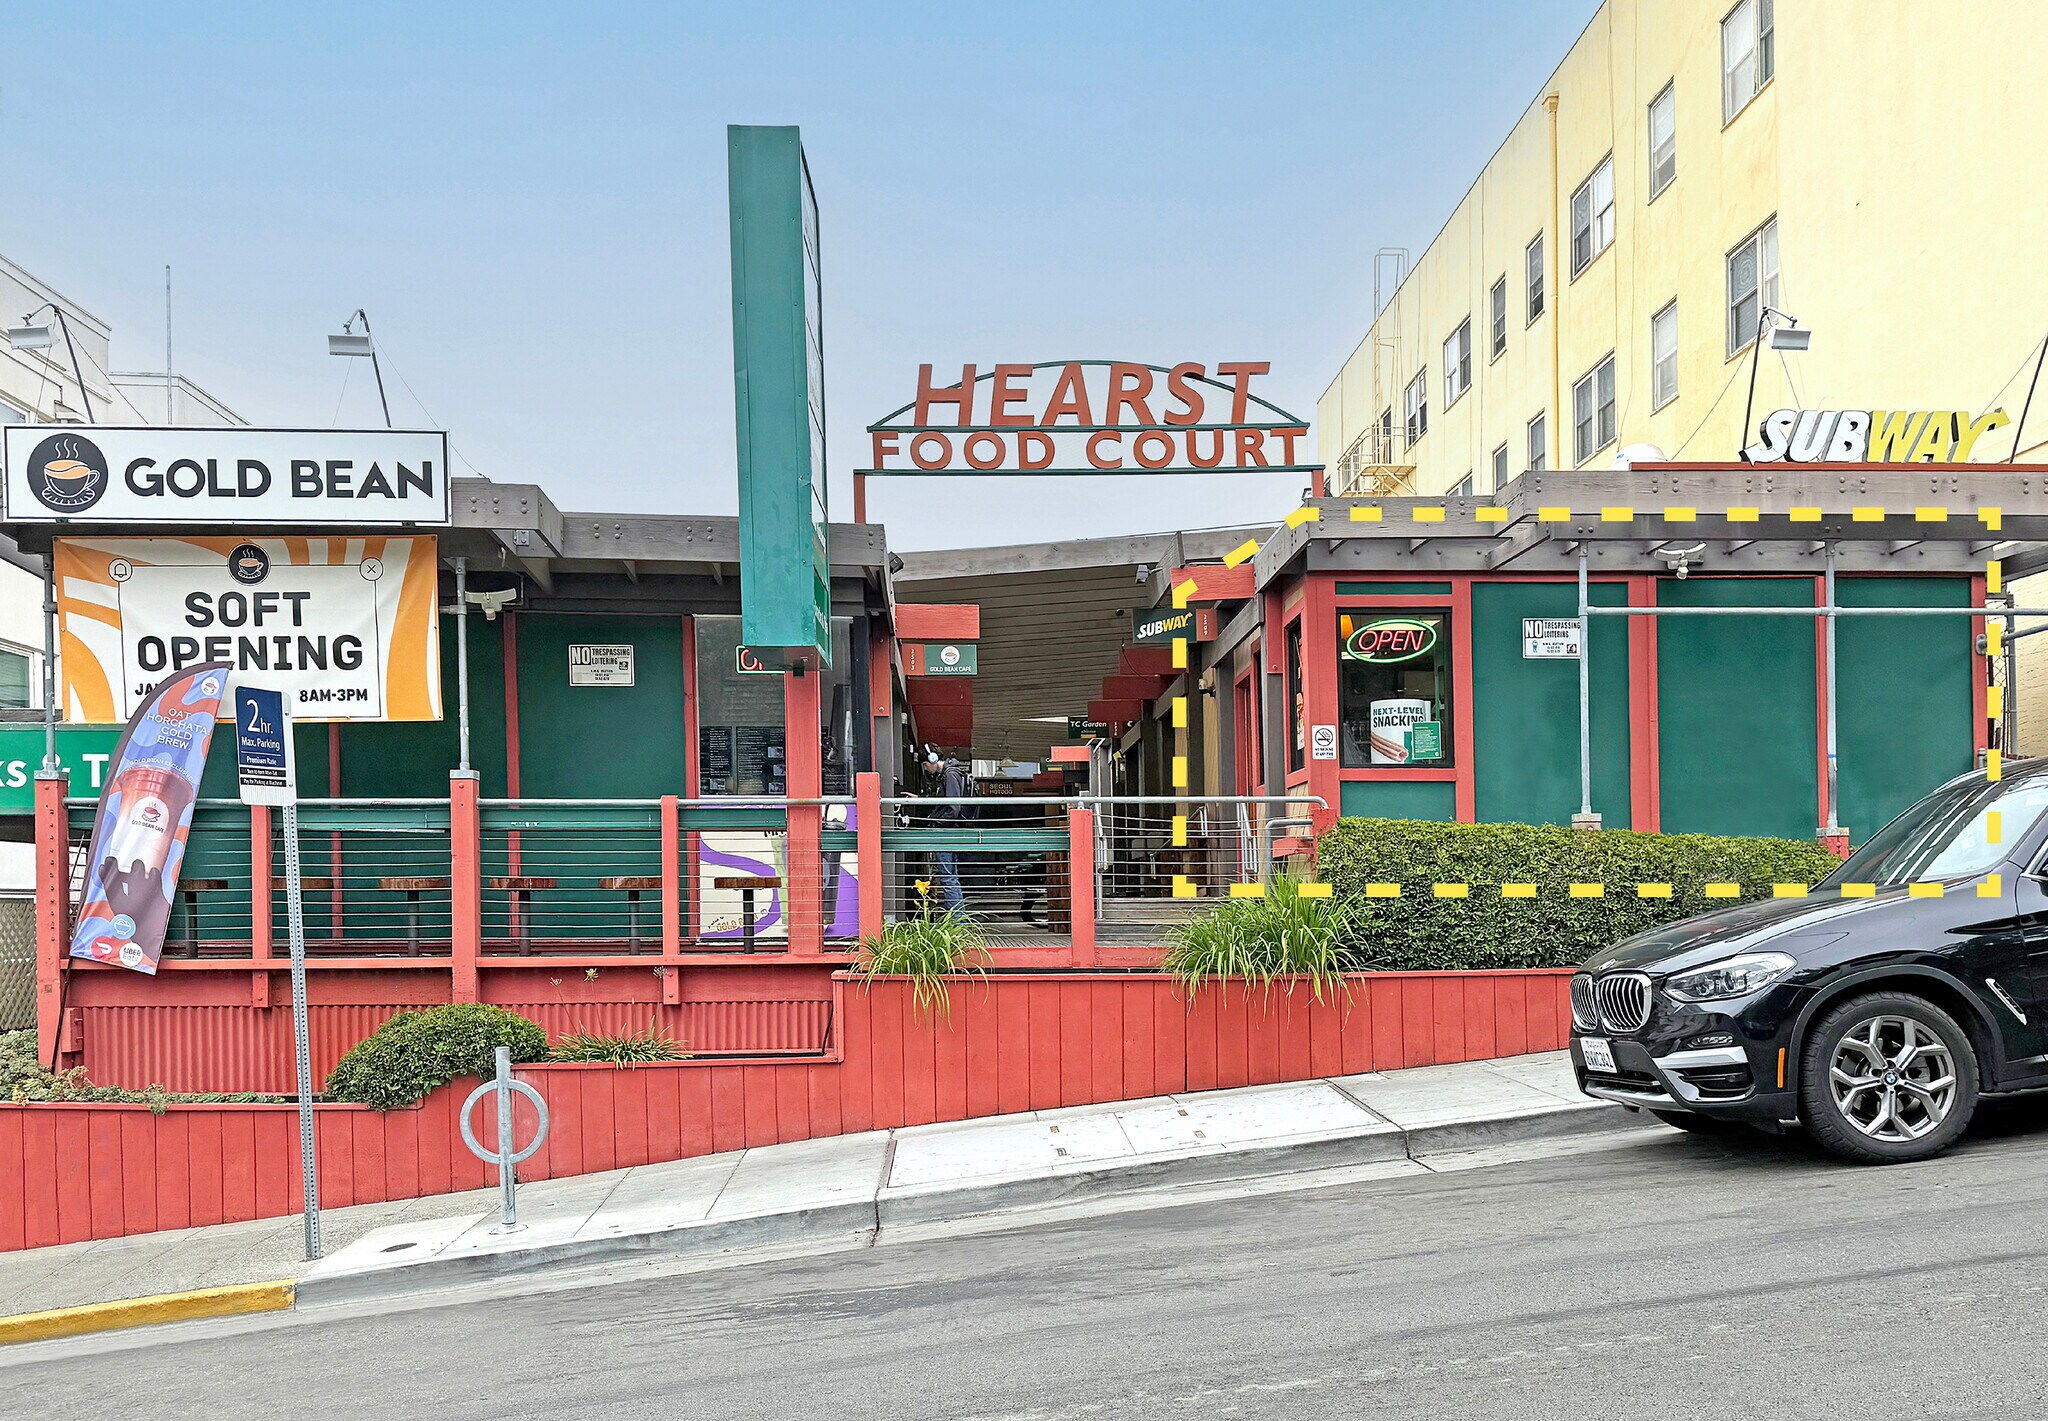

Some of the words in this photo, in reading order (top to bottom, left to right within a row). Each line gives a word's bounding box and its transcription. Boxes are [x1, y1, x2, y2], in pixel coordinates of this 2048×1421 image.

[914, 361, 1271, 427] HEARST
[1738, 407, 2011, 466] SUBWAY
[872, 430, 1056, 471] FOOD
[1085, 428, 1308, 469] COURT
[124, 457, 272, 498] GOLD
[291, 460, 434, 499] BEAN
[185, 591, 311, 628] SOFT
[1136, 612, 1193, 639] SUBWAY
[1525, 620, 1543, 638] NO
[1544, 621, 1581, 629] TRESPASSING
[1358, 630, 1424, 652] OPEN
[1544, 630, 1569, 638] LOITERING
[137, 634, 363, 672] OPENING
[571, 646, 591, 665] NO
[592, 648, 631, 656] TRESPASSING
[592, 657, 618, 665] LOITERING
[134, 683, 160, 696] JA
[299, 688, 368, 703] 8AM-3PM
[1373, 707, 1424, 716] NEXT-LEVEL
[161, 726, 193, 741] COLD
[156, 735, 191, 751] BREW.
[257, 738, 280, 751] Parking
[129, 758, 146, 766] GOLD
[246, 755, 266, 765] Premium
[82, 753, 110, 788] T
[716, 919, 737, 932] GOLD
[123, 946, 141, 957] UBER
